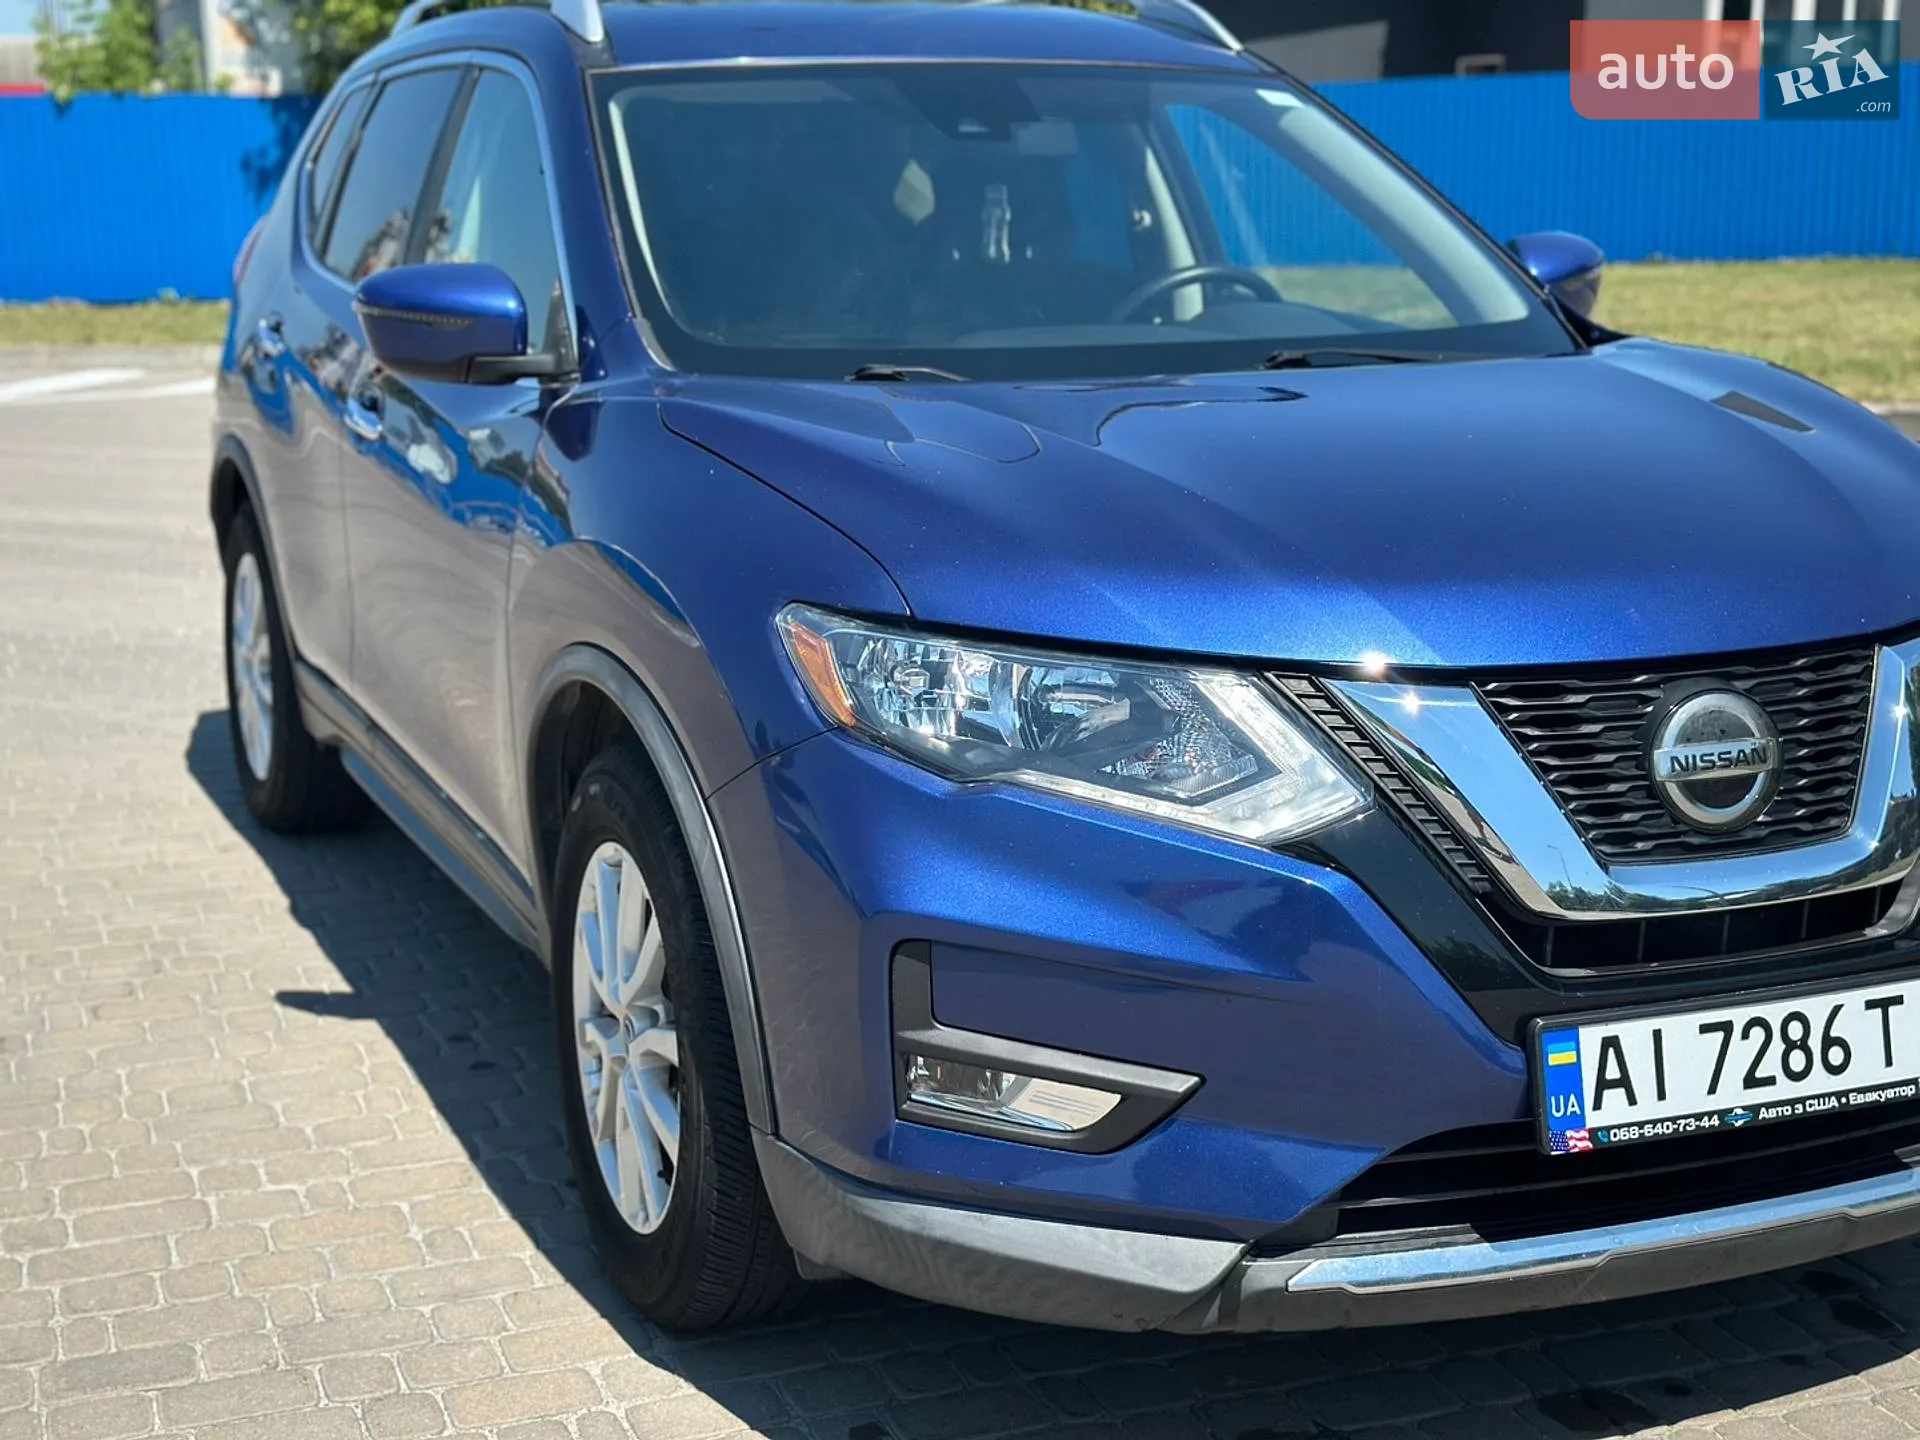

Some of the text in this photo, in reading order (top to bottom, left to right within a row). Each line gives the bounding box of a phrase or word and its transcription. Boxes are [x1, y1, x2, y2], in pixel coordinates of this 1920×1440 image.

[1669, 747, 1768, 773] NISSAN
[1592, 994, 1905, 1112] AI 7286 T
[1551, 1093, 1581, 1118] UA
[1610, 1114, 1720, 1142] 068-640-73-44
[1758, 1106, 1792, 1120] Авто
[1805, 1096, 1839, 1112] США
[1849, 1084, 1916, 1105] Евакуатор
